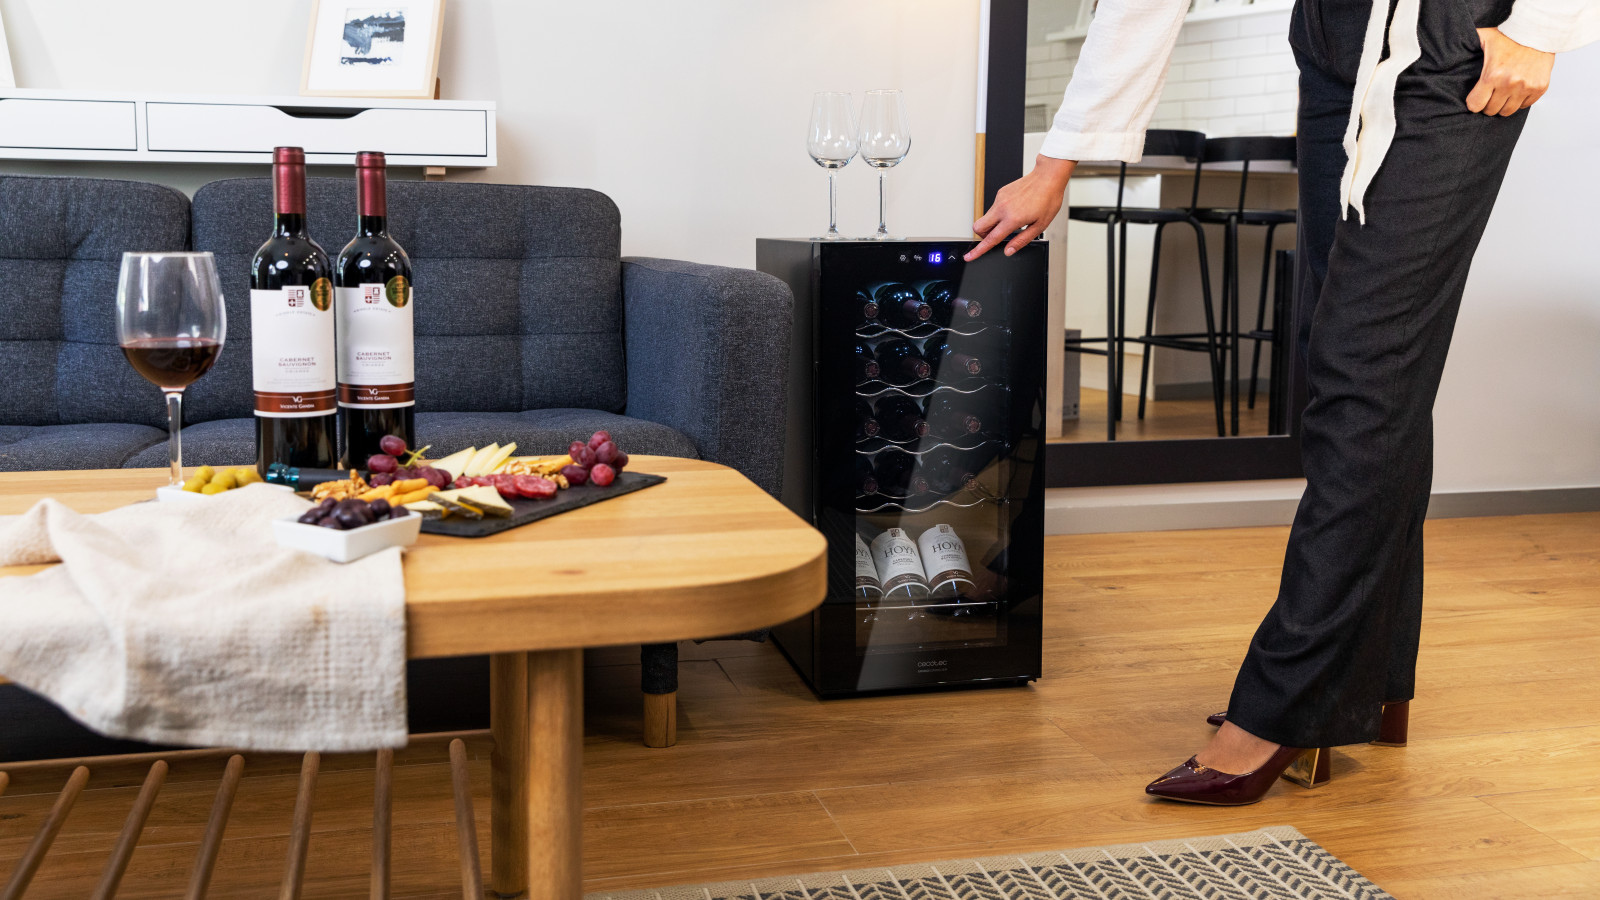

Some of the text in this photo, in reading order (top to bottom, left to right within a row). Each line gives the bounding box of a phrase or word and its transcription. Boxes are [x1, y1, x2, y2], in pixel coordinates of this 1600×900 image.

[930, 253, 941, 263] 16
[884, 545, 917, 558] HOYA
[931, 541, 964, 553] HOYA
